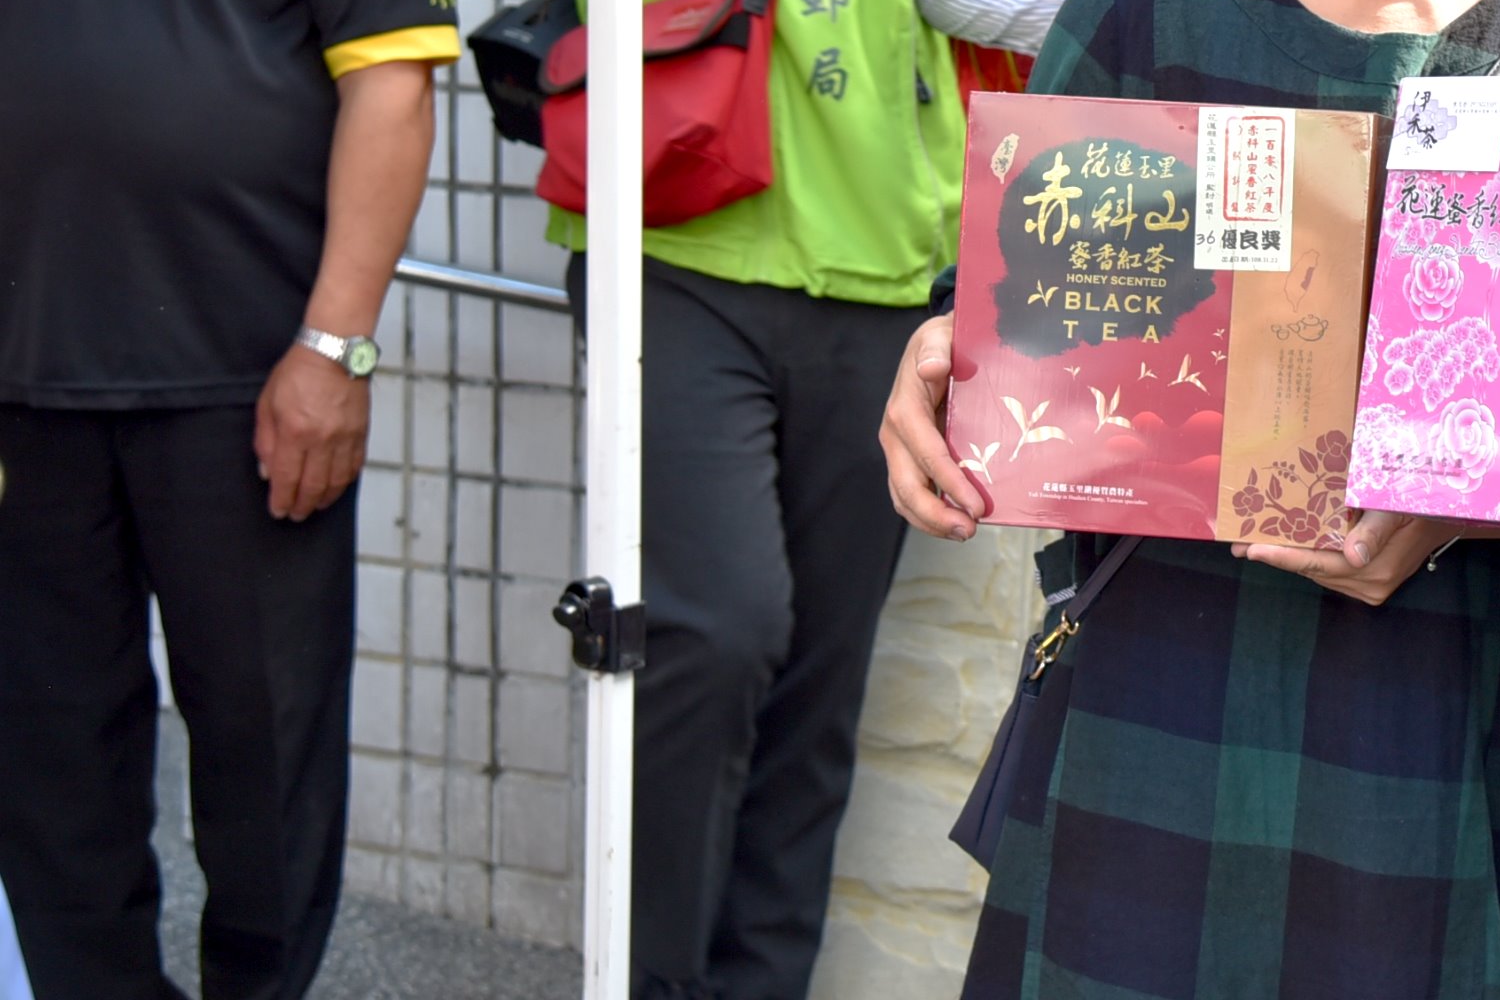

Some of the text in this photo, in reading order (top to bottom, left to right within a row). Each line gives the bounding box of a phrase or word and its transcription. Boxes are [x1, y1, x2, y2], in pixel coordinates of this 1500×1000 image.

[1080, 142, 1176, 179] 花蓮玉里
[1263, 127, 1278, 214] 一百零八年度
[1023, 151, 1190, 246] 赤科山
[1221, 228, 1281, 251] 優良獎
[1068, 241, 1174, 274] 蜜香紅茶
[1066, 273, 1167, 288] HONEY SCENTED
[1064, 291, 1164, 315] BLACK
[1063, 320, 1160, 344] TEA
